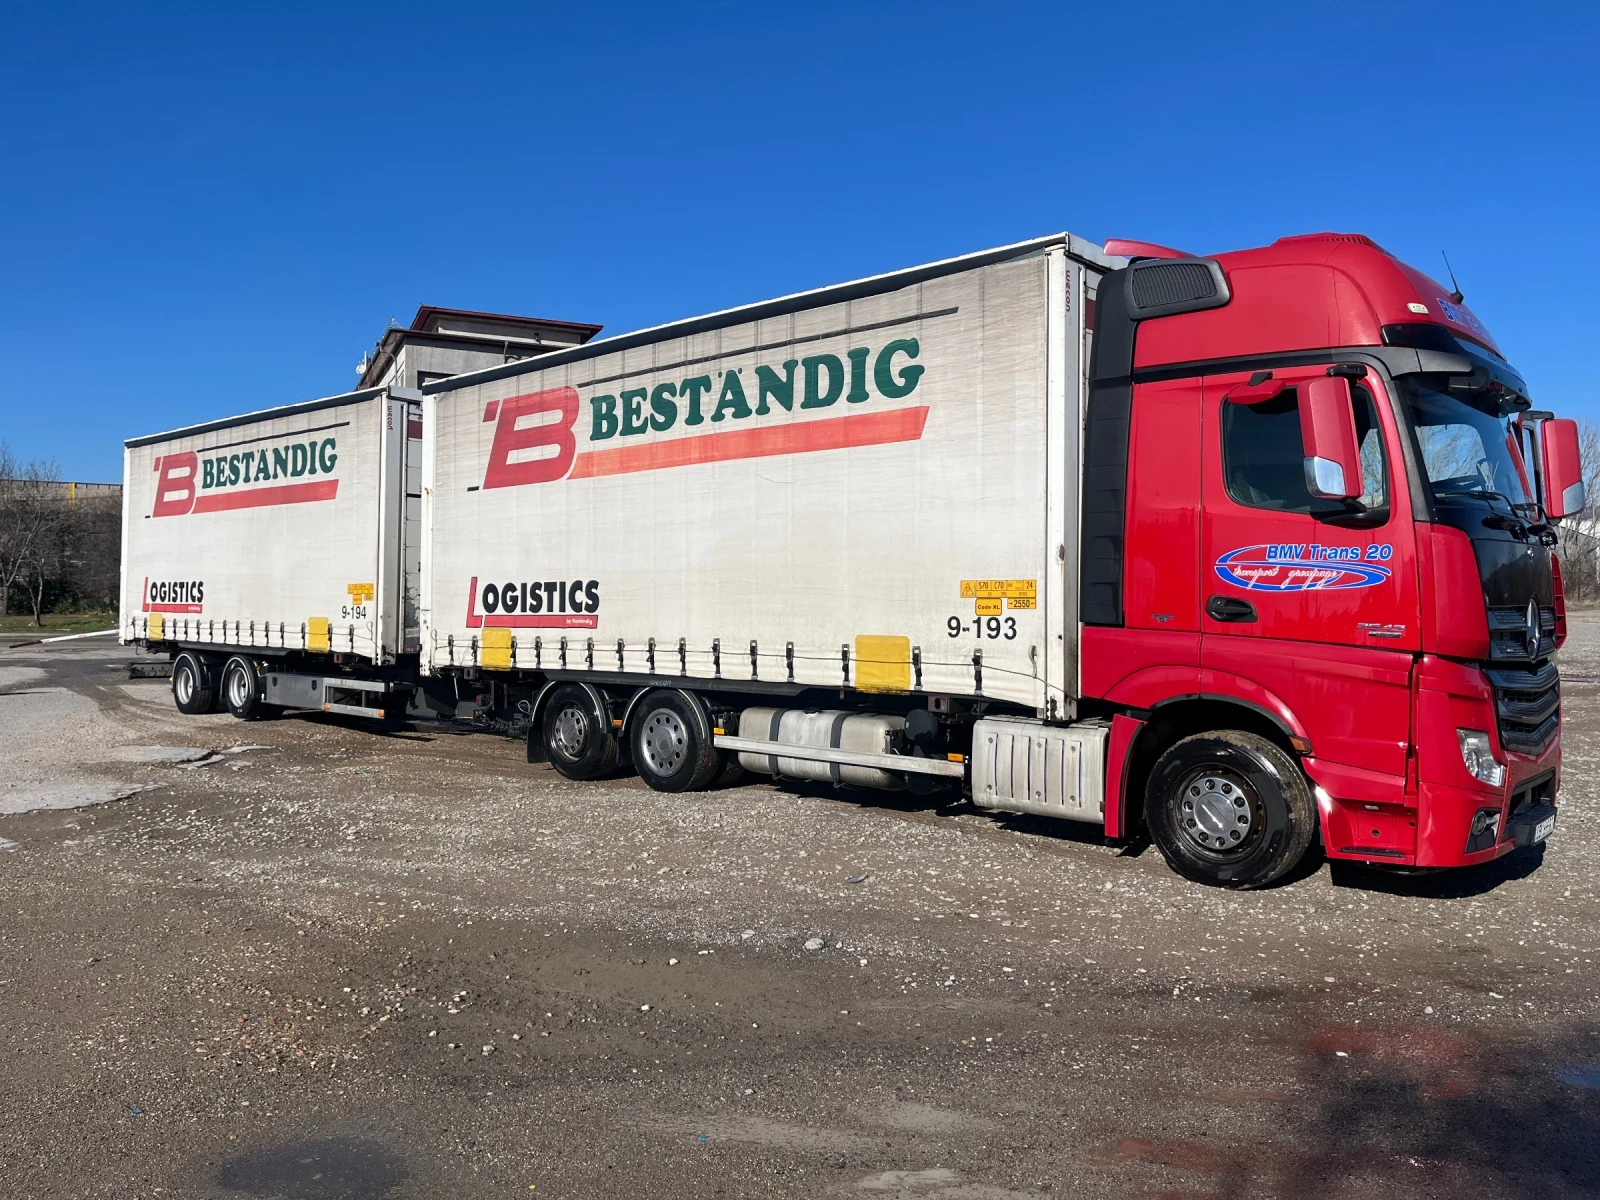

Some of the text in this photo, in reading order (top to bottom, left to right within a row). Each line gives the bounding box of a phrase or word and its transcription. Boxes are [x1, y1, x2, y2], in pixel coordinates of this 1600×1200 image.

[590, 337, 926, 441] BESTÄNDIG
[202, 437, 338, 489] BESTÄNDIG
[1266, 544, 1393, 561] BMV Trans 20
[341, 605, 366, 620] 9-194
[1013, 599, 1030, 608] 2550
[947, 616, 1017, 640] 9-193
